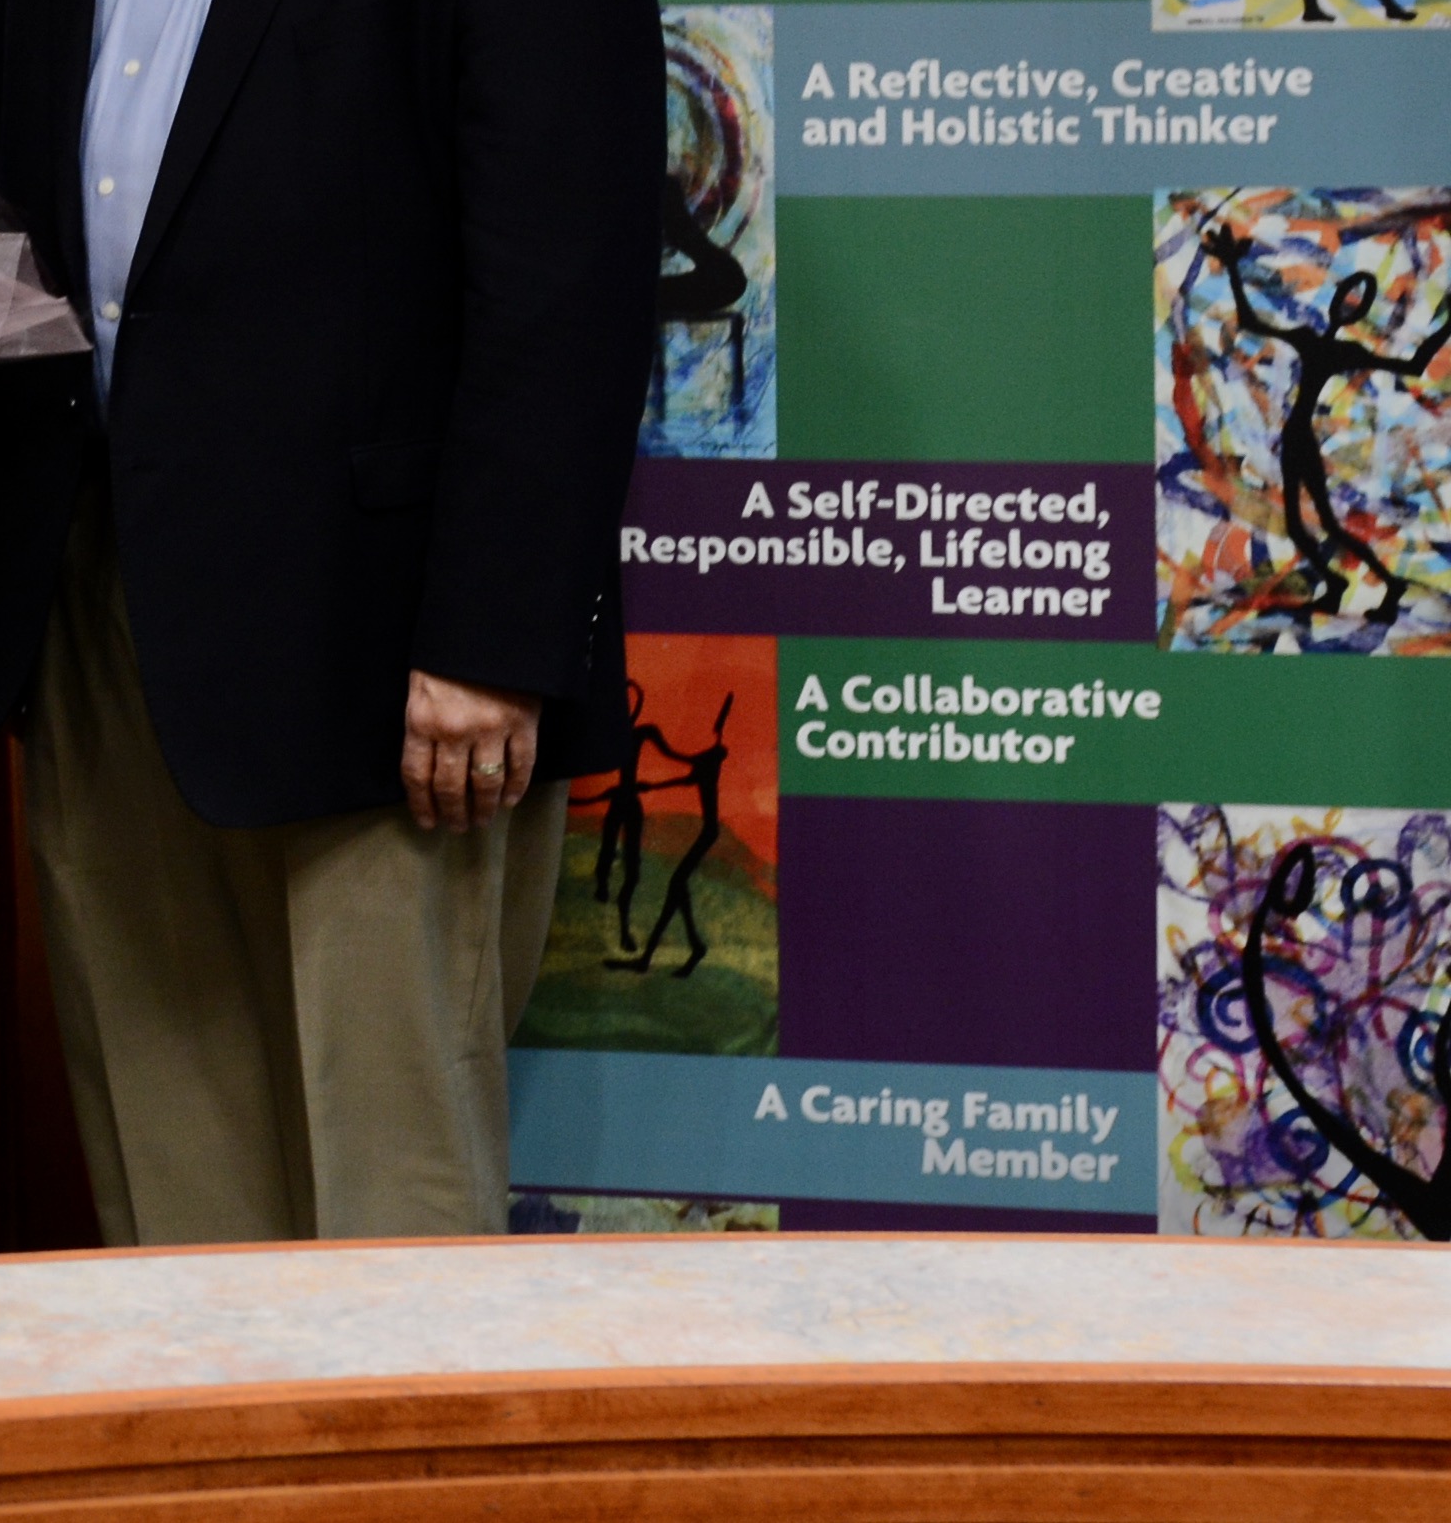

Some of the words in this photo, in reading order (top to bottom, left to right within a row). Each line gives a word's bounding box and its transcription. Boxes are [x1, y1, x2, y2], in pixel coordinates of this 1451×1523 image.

[802, 63, 834, 98] A
[849, 59, 1097, 103] Reflective,
[1113, 58, 1312, 97] Creative
[803, 107, 886, 145] and
[902, 106, 1079, 145] Holistic
[1093, 104, 1277, 144] Thinker
[742, 482, 774, 518] A
[788, 481, 1109, 529] Self-Directed,
[621, 527, 905, 573] Responsible,
[921, 528, 1110, 580] Lifelong
[932, 577, 1110, 616] Learner
[796, 675, 828, 711] A
[842, 675, 1161, 719] Collaborative
[796, 721, 1075, 763] Contributor
[755, 1084, 787, 1120] A
[801, 1085, 949, 1136] Caring
[964, 1092, 1118, 1144] Family
[923, 1139, 1118, 1181] Member
